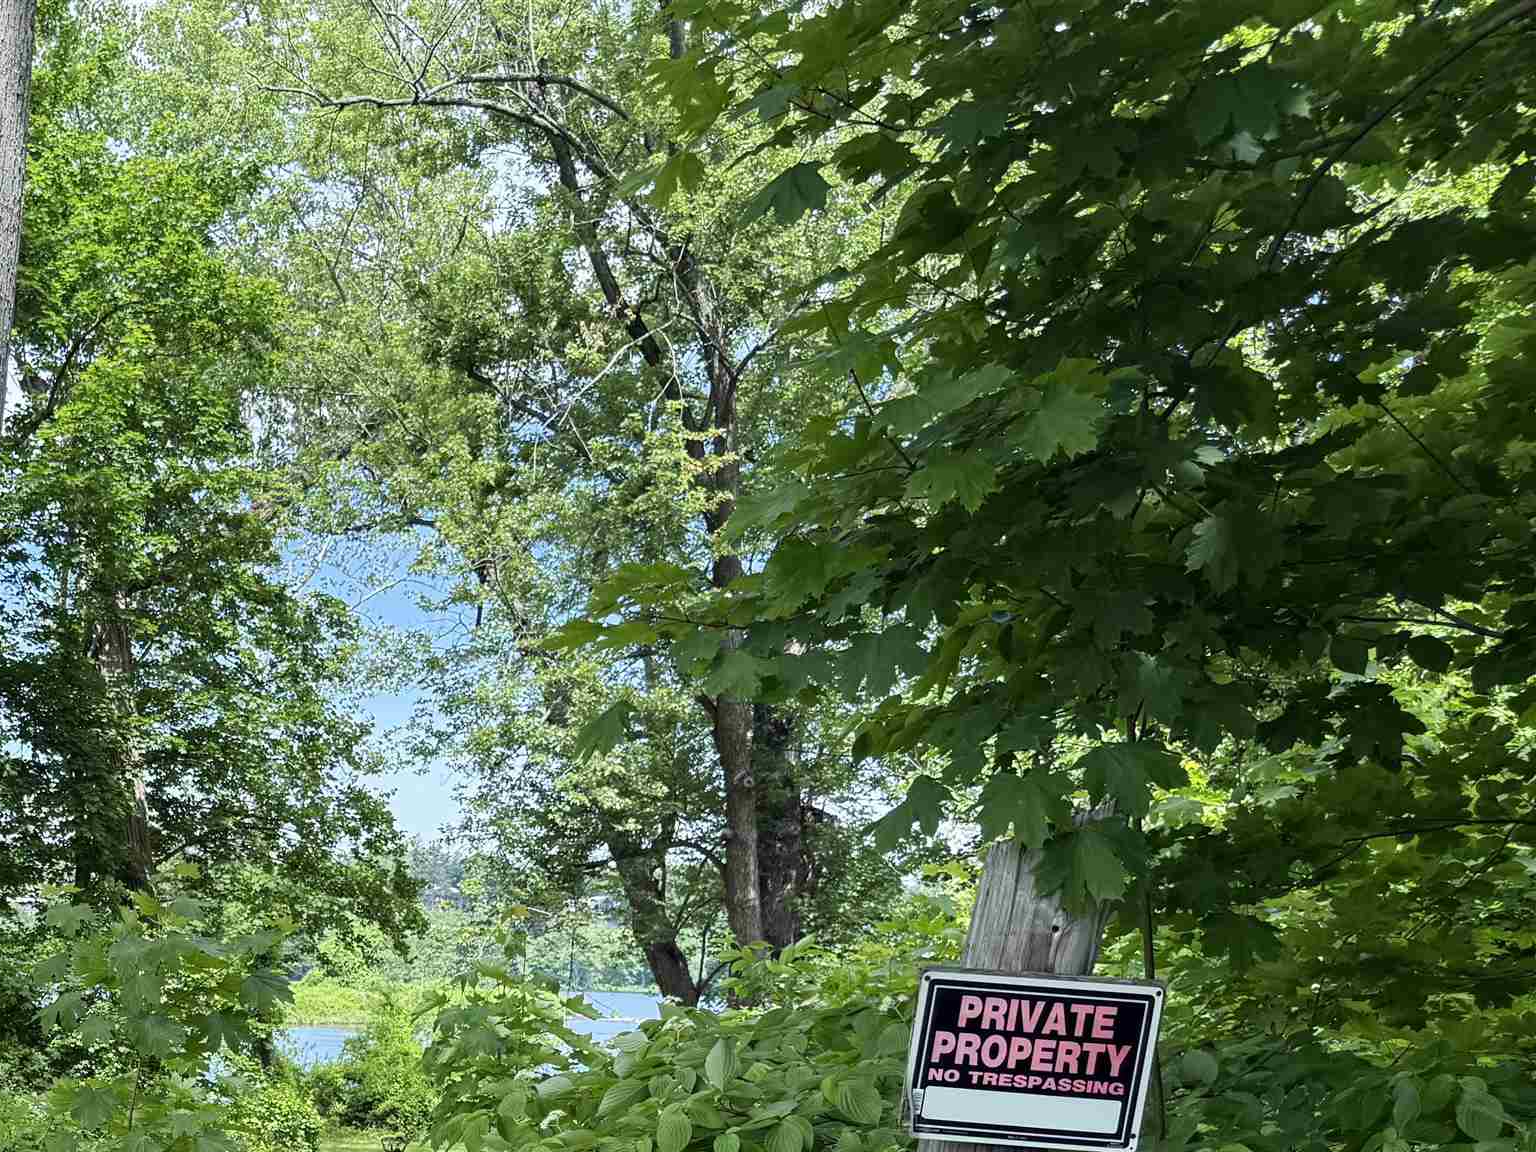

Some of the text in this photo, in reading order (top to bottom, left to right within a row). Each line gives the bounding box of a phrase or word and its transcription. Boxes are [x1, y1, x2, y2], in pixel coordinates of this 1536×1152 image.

[957, 995, 1119, 1040] PRIVATE
[930, 1030, 1132, 1077] PROPERTY
[927, 1067, 1125, 1096] NO TRESPASSING
